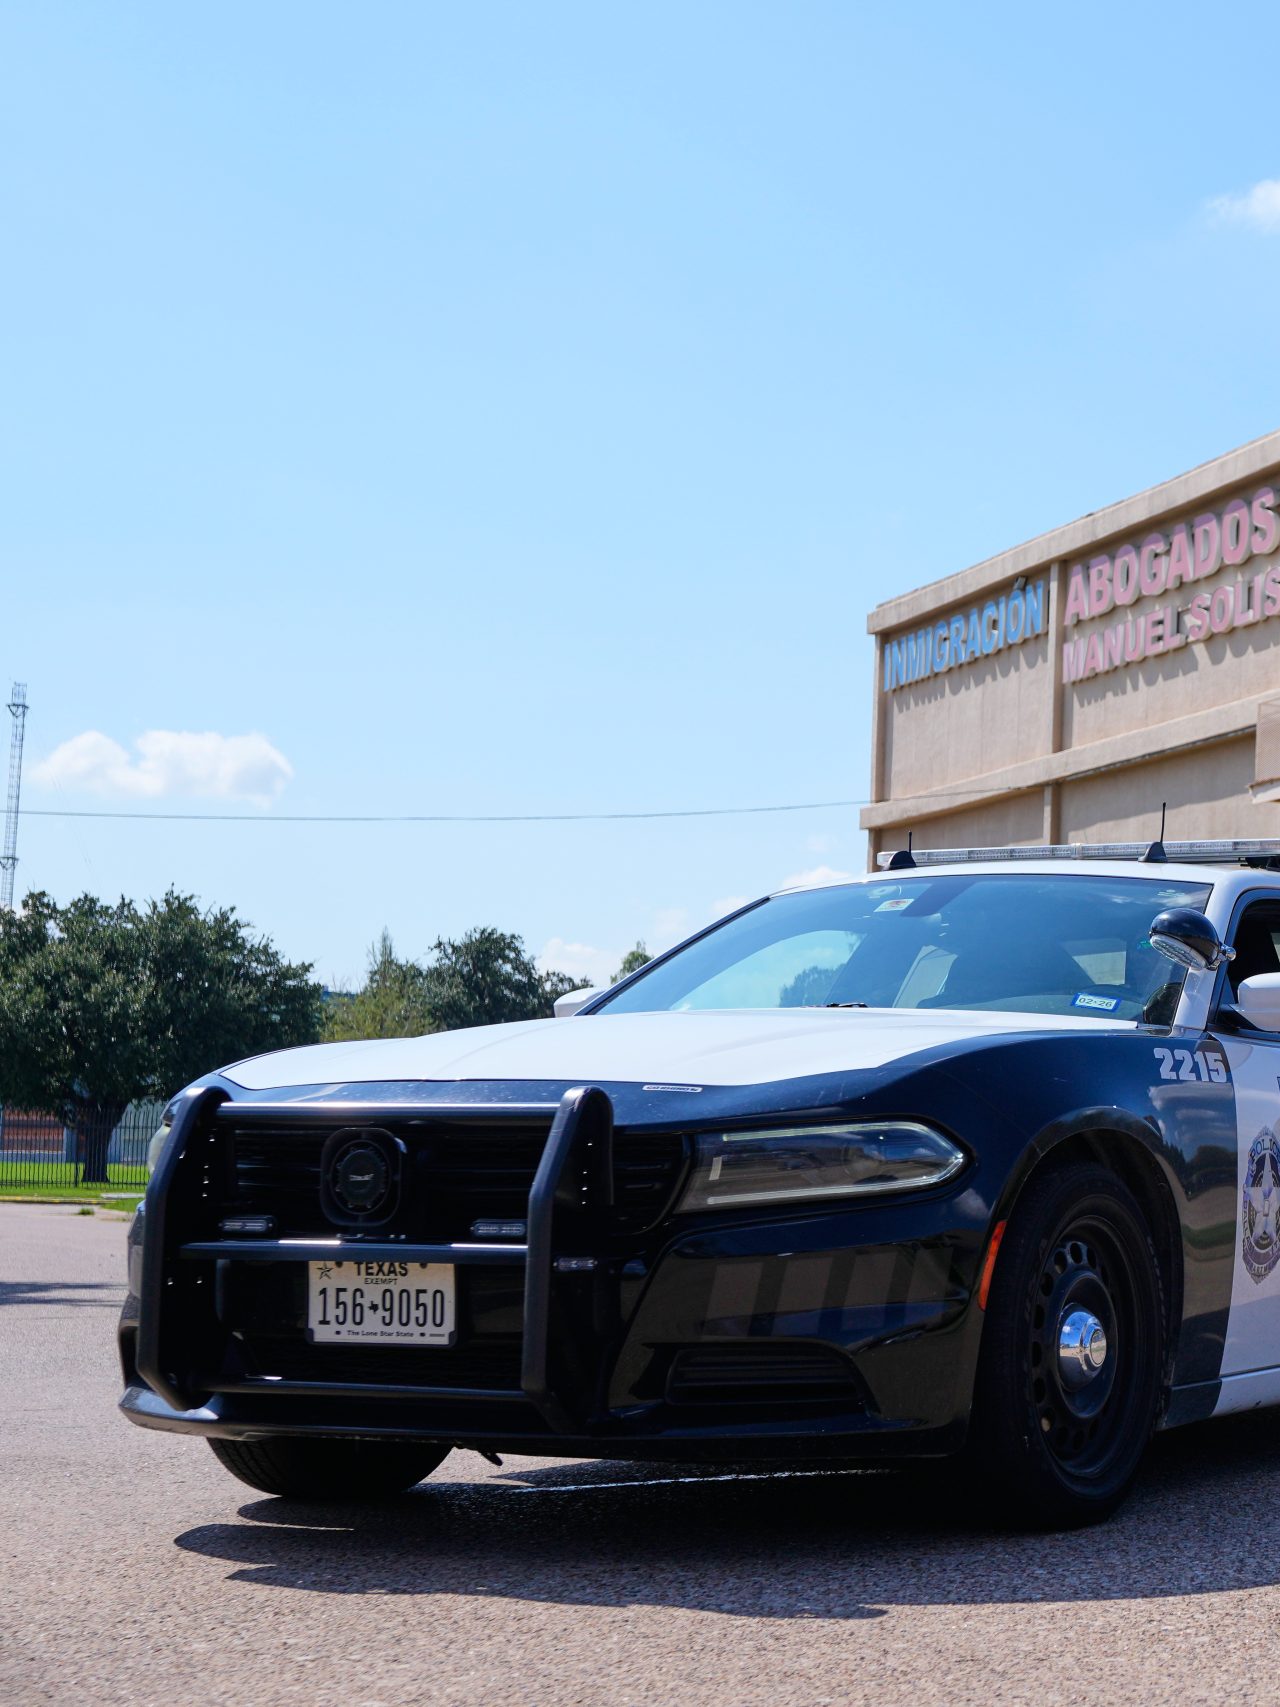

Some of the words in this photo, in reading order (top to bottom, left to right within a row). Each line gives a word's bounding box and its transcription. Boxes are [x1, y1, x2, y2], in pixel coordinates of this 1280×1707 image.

[1062, 604, 1187, 684] MANUEL
[1153, 1047, 1228, 1083] 2215
[355, 1262, 409, 1277] TEXAS
[364, 1277, 398, 1286] EXEMPT
